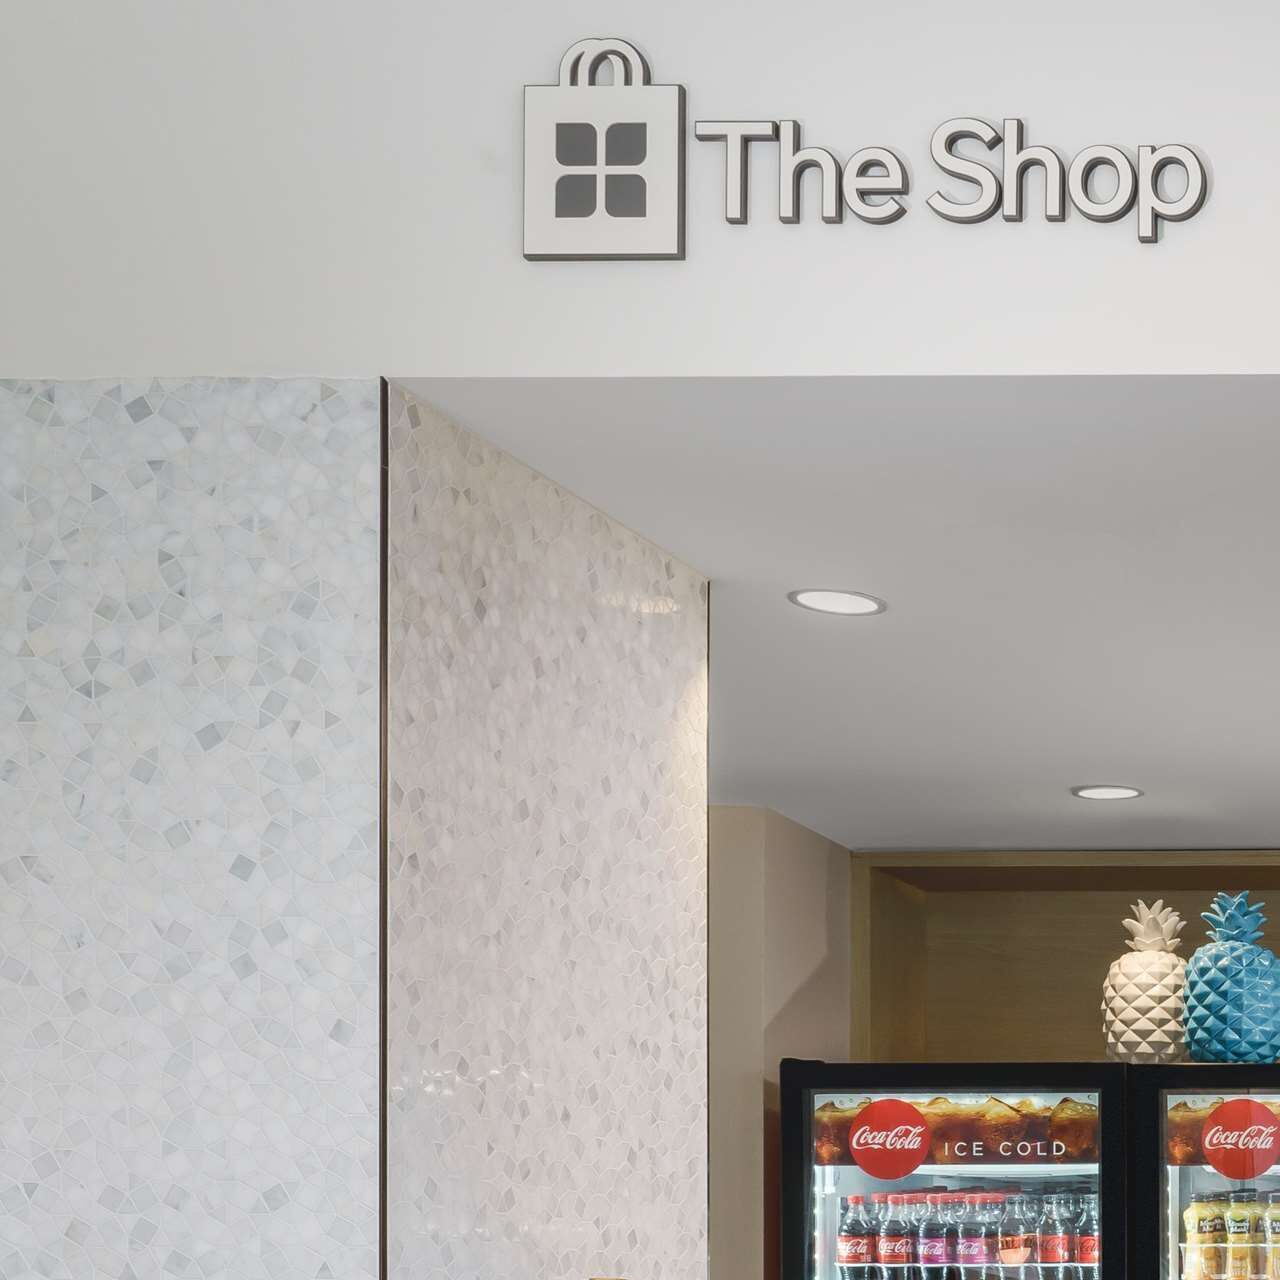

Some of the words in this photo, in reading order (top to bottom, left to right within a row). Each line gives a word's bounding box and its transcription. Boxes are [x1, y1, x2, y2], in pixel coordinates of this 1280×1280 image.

[695, 119, 909, 225] The
[926, 116, 1210, 244] Shop
[852, 1124, 926, 1151] Coca-Cola
[944, 1141, 984, 1157] ICE
[999, 1141, 1067, 1157] COLD
[1204, 1124, 1278, 1151] Coca-Cola
